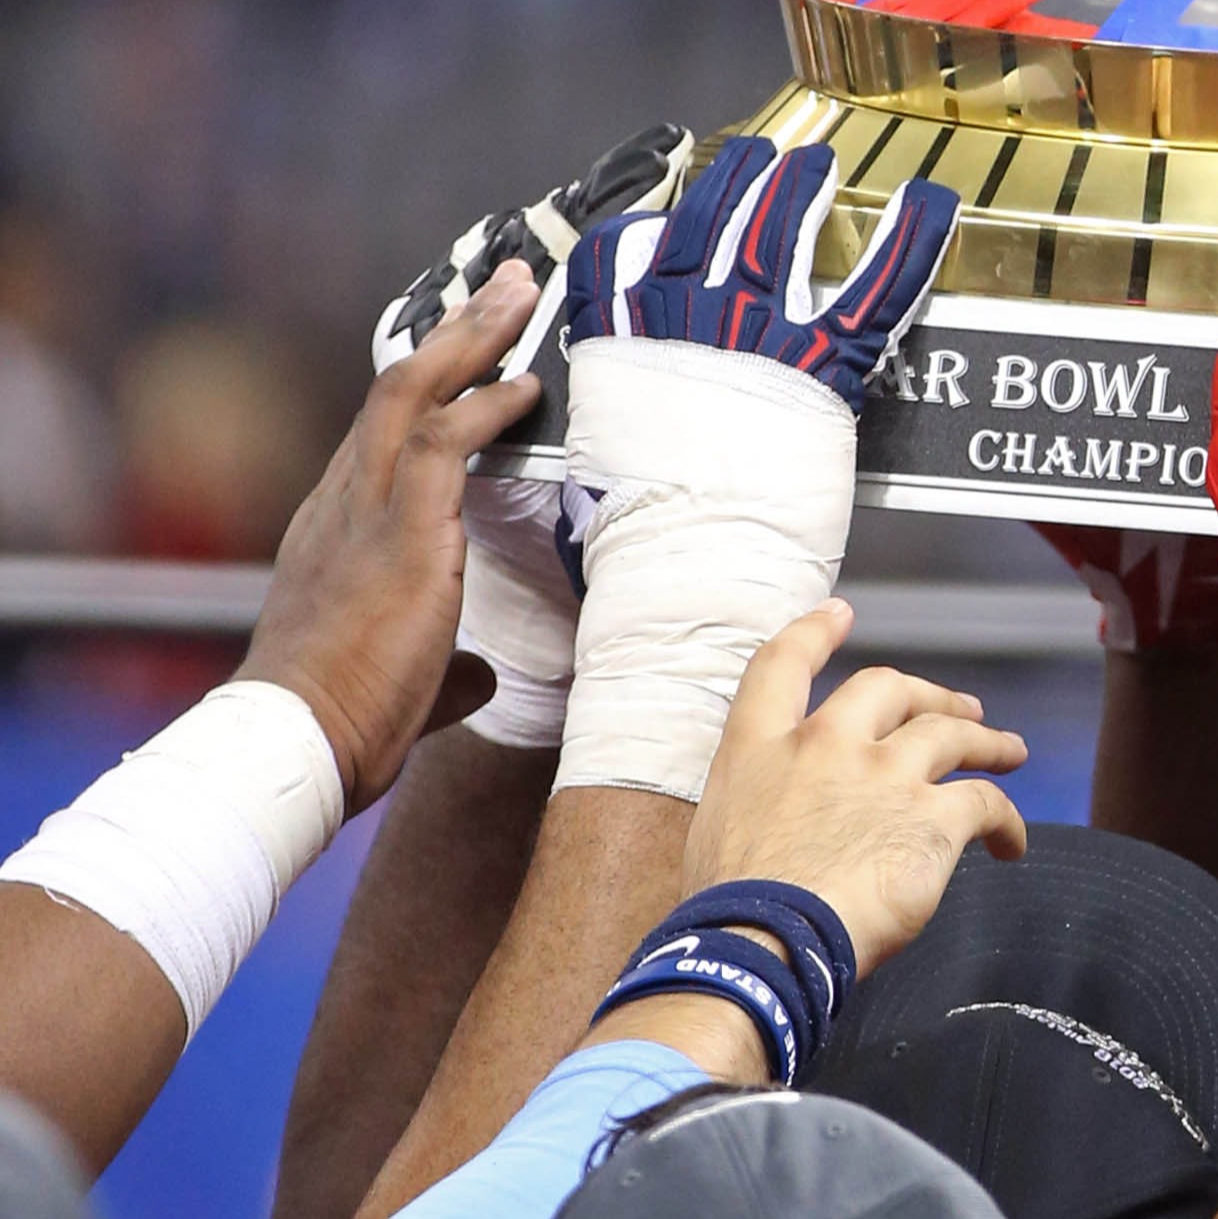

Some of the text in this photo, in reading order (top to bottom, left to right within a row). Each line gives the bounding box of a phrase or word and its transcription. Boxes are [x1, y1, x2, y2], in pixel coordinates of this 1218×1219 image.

[991, 353, 1189, 423] BOWL
[968, 429, 1209, 487] CHAMPIO
[676, 959, 772, 1006] STAND
[774, 1003, 788, 1026] A
